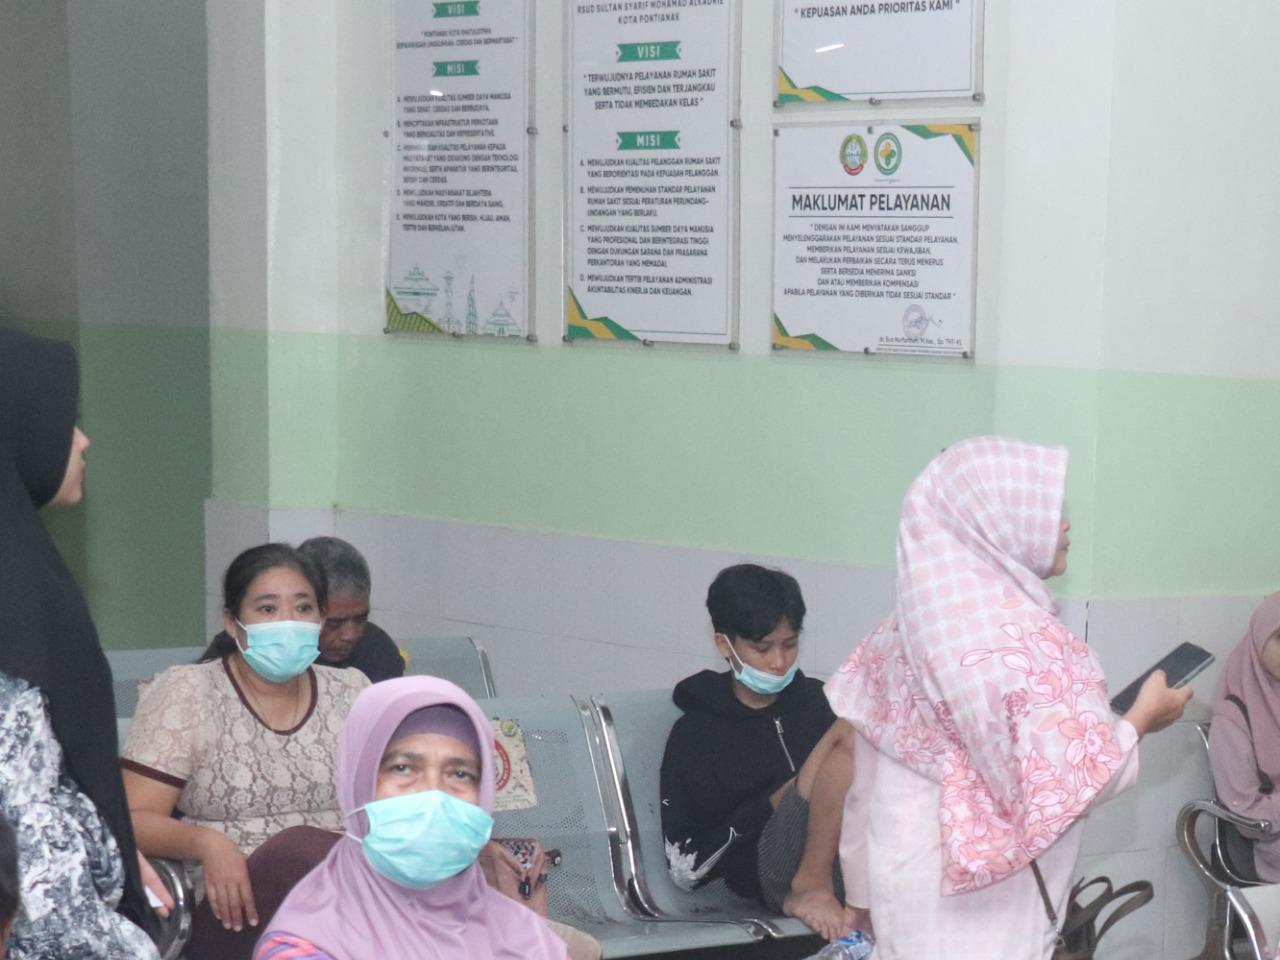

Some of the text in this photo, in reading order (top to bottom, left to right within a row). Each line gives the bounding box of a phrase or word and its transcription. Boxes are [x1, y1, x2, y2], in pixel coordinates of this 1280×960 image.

[801, 1, 952, 18] KEPUASAN ANDA PRIORITAS KAMI
[637, 46, 660, 58] VISI
[634, 71, 671, 80] PELAYANAN
[585, 88, 601, 96] YANG
[657, 85, 671, 93] DAN
[595, 101, 613, 110] SERTA
[614, 101, 632, 109] TIDAK
[637, 135, 660, 147] MISI
[792, 194, 950, 211] MAKLUMAT PELAYANAN
